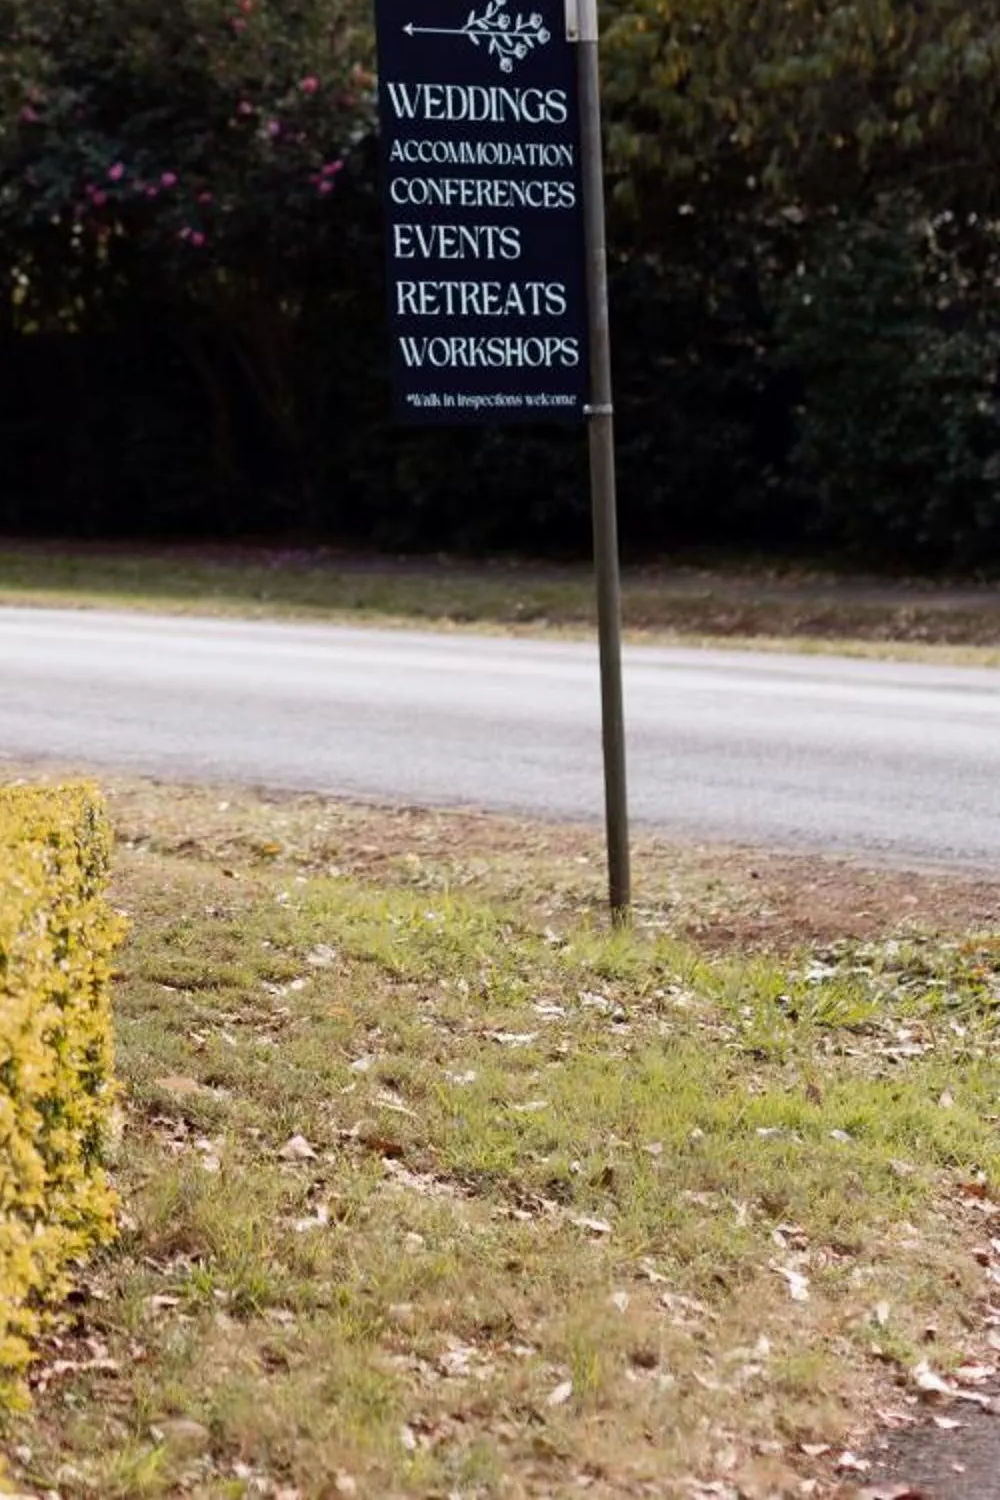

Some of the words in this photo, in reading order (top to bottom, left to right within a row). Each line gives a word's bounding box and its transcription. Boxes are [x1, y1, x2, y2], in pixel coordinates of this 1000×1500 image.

[387, 82, 568, 124] WEDDINGS
[390, 139, 574, 167] ACCOMMODATION
[390, 177, 575, 208] CONFERENCES
[393, 223, 521, 260] EVENTS
[396, 281, 567, 316] RETREATS
[399, 336, 579, 368] WORKSHOPS
[524, 393, 577, 407] welcome
